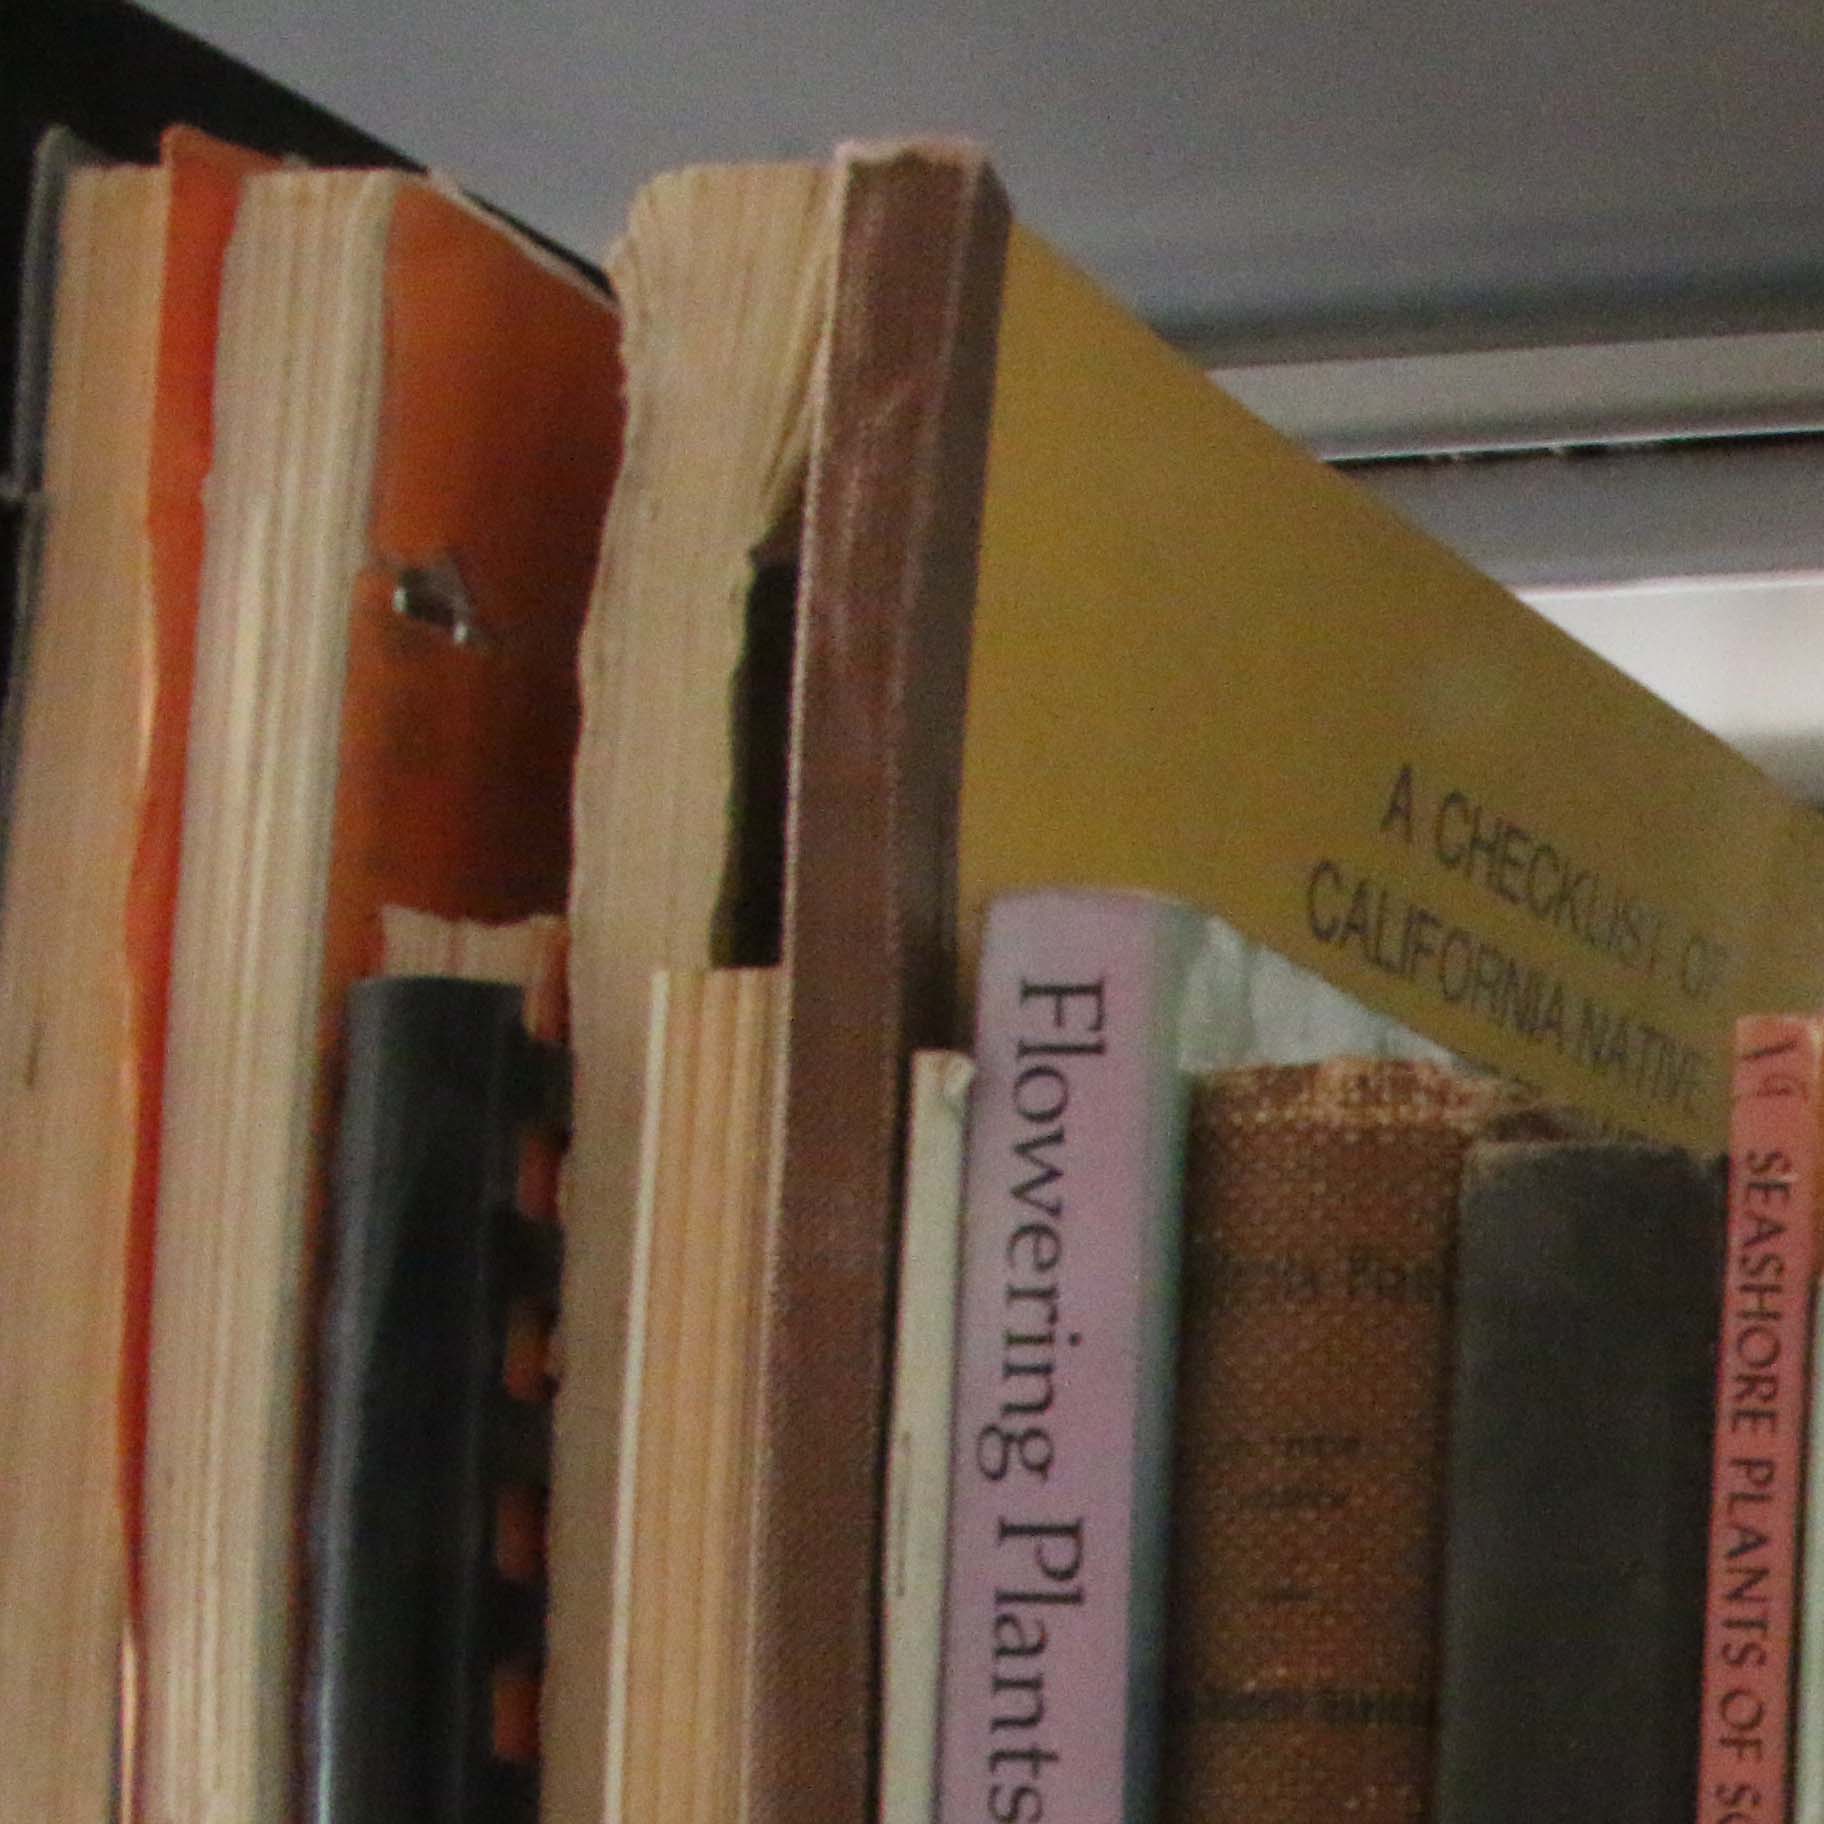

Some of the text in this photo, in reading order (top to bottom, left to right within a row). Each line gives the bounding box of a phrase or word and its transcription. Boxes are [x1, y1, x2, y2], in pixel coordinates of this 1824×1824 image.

[1379, 763, 1413, 845] A
[1305, 859, 1567, 1054] CALIFORNIA
[976, 976, 1106, 1482] Flowering
[1730, 1148, 1792, 1434] SEASHORE
[1720, 1456, 1777, 1668] PLANTS
[988, 1518, 1084, 1824] Plants
[1718, 1688, 1764, 1765] OF
